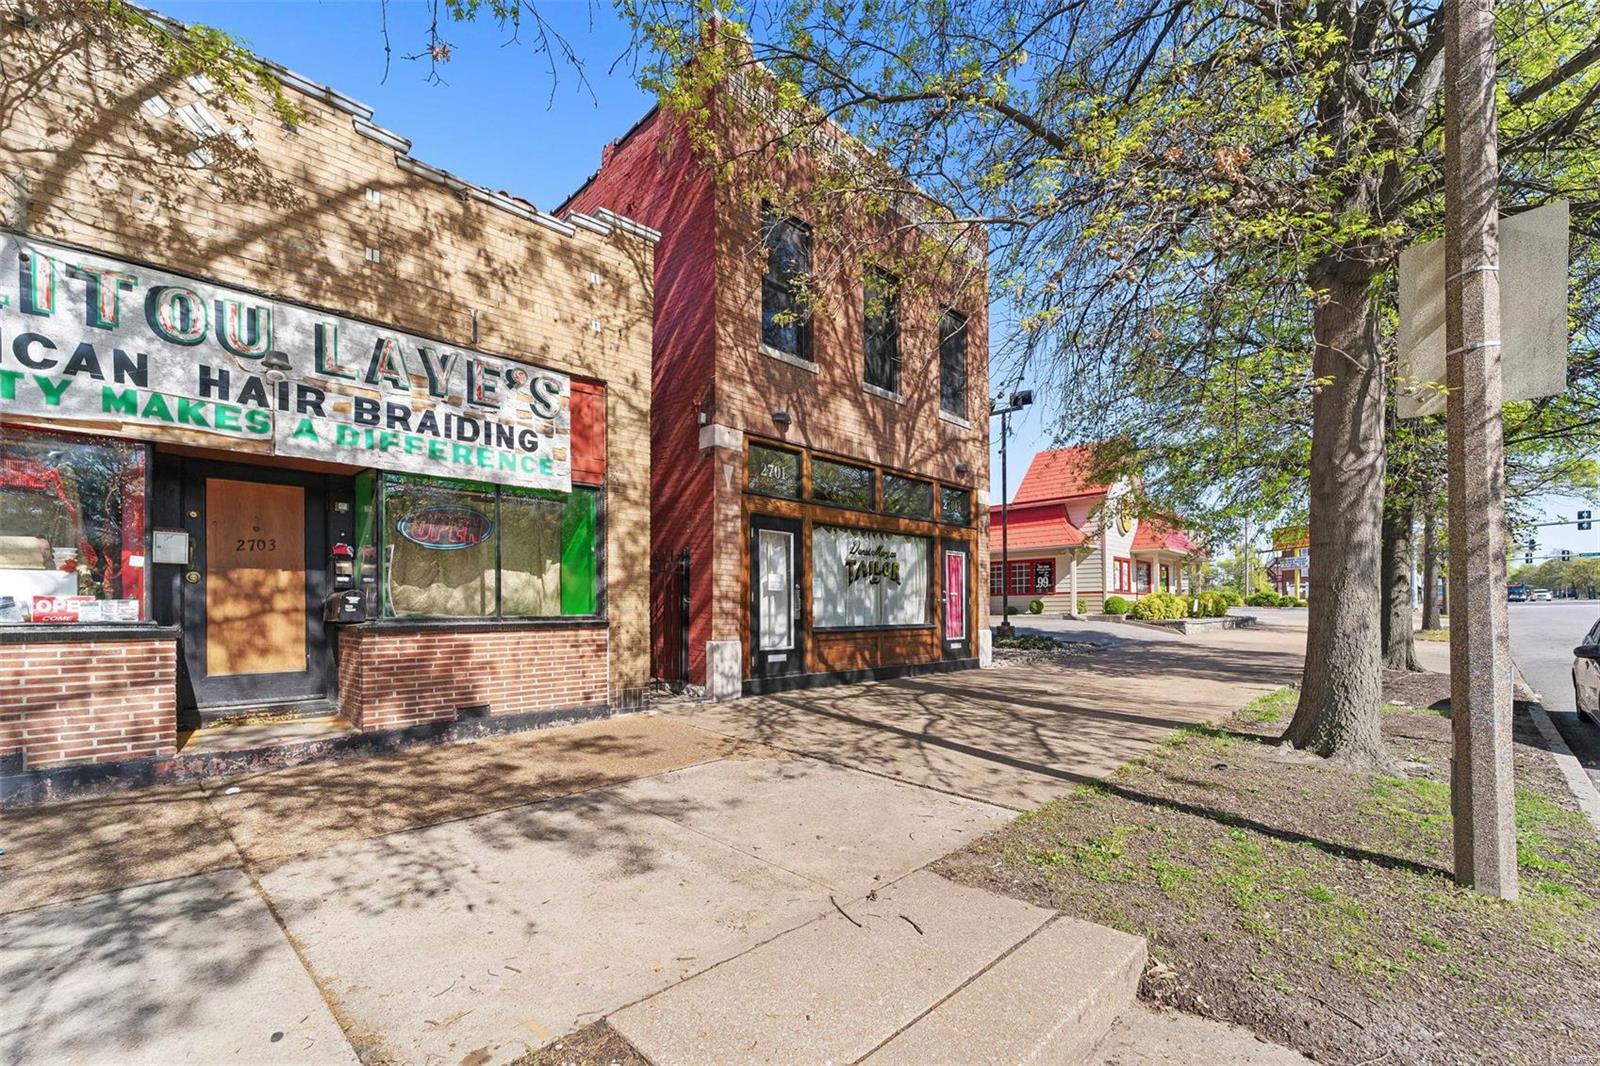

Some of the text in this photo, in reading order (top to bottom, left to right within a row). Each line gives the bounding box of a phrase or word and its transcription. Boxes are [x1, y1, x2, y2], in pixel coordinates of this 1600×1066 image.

[0, 251, 563, 420] ITOU LAYE'S
[0, 326, 539, 453] CAN HAIR BRAIDING
[102, 385, 271, 434] MAKES
[293, 417, 319, 443] A
[336, 424, 554, 476] DIFFERENCE
[760, 462, 786, 480] 2701
[236, 539, 276, 551] 2703
[845, 559, 901, 587] TAILOR
[36, 599, 80, 613] OPE
